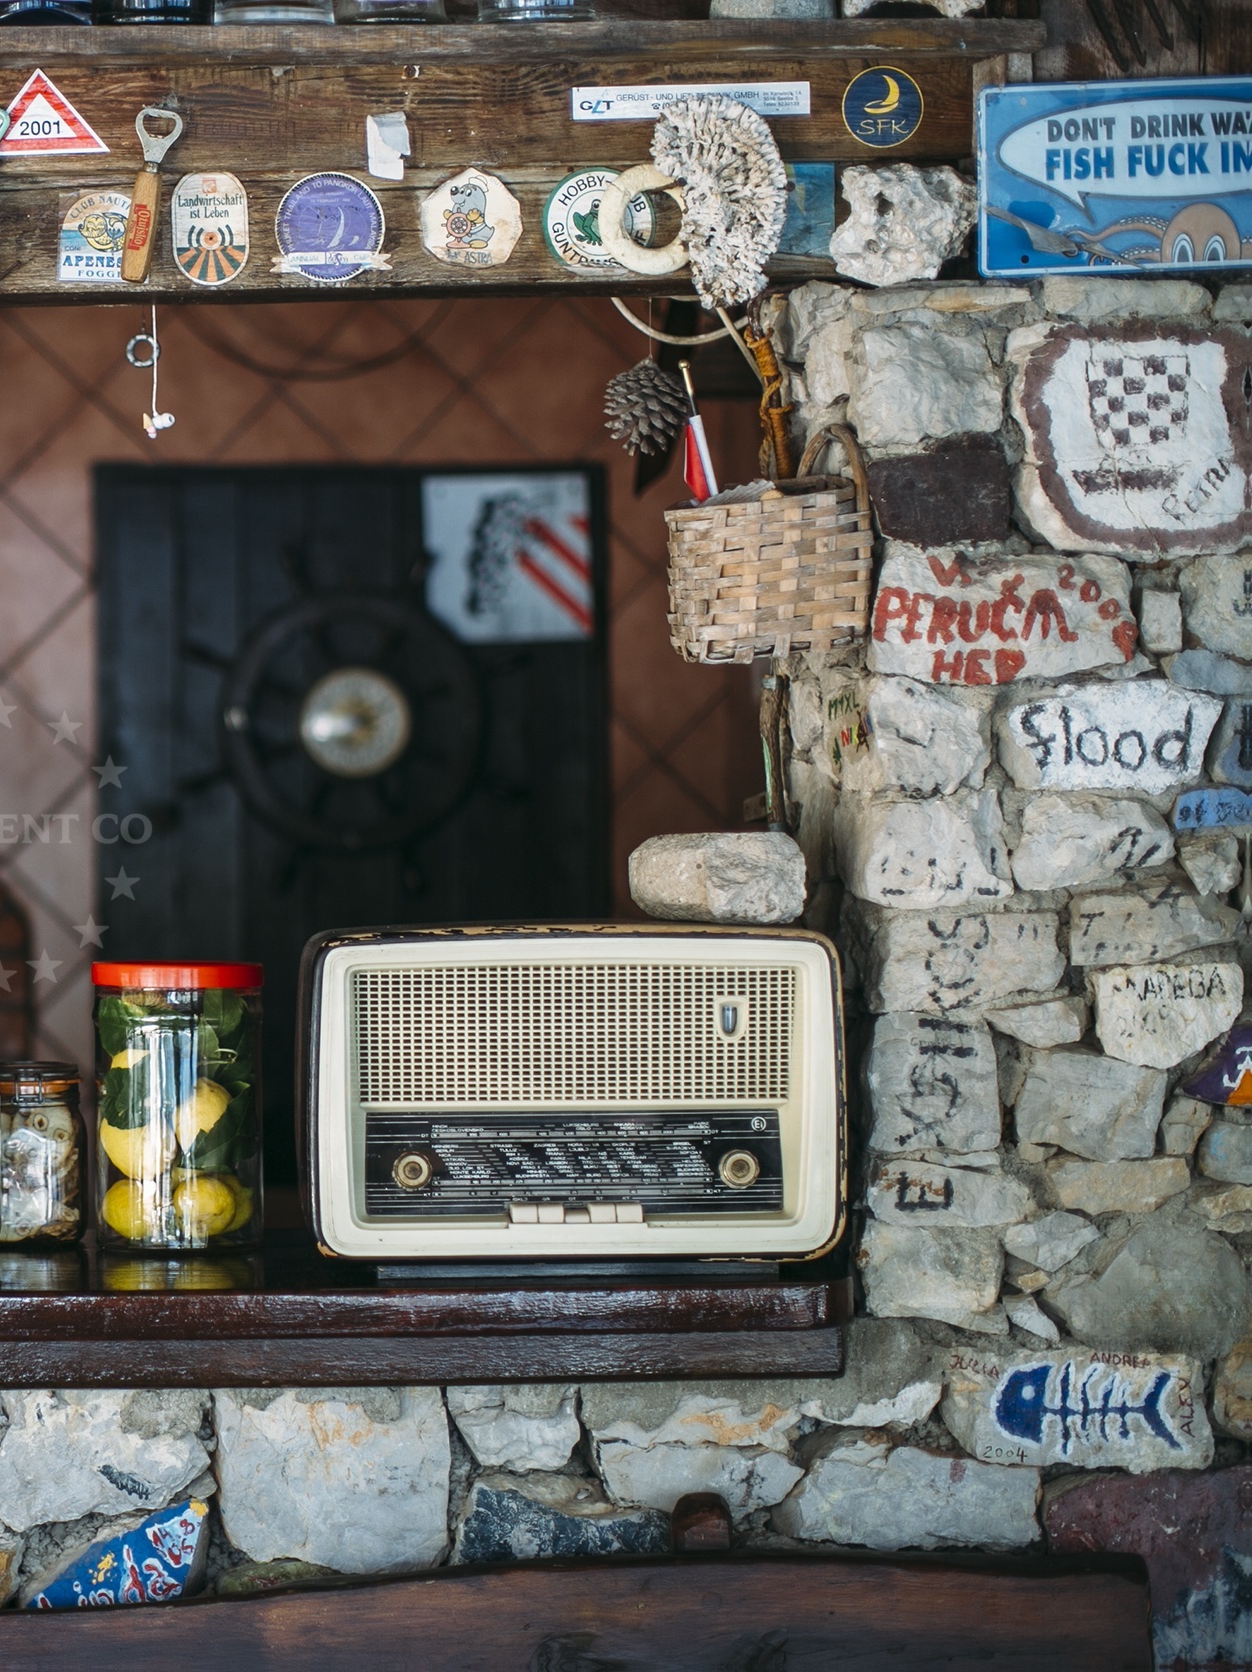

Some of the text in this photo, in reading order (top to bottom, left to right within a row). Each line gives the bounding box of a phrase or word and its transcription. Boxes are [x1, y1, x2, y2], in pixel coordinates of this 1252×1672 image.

[655, 92, 673, 101] UND
[734, 91, 759, 99] GMBH
[19, 121, 62, 136] 2001
[856, 118, 910, 135] SFK
[1047, 117, 1116, 143] DON'T
[1131, 113, 1205, 139] DRINK
[1046, 146, 1115, 181] FISH
[1128, 142, 1210, 178] FUCK
[70, 195, 131, 219] CLUB NAUTI
[178, 193, 243, 208] Landwirtschaft
[190, 206, 229, 219] ist Leben
[282, 179, 378, 252] PHUKET THAILAND TO PANGKOR LAUT MALAYSIA
[62, 255, 122, 268] APENES
[464, 251, 493, 264] ASTRA
[1020, 702, 1193, 773] flood
[1090, 1352, 1150, 1369] ANDREA
[983, 1446, 1028, 1463] 2004
